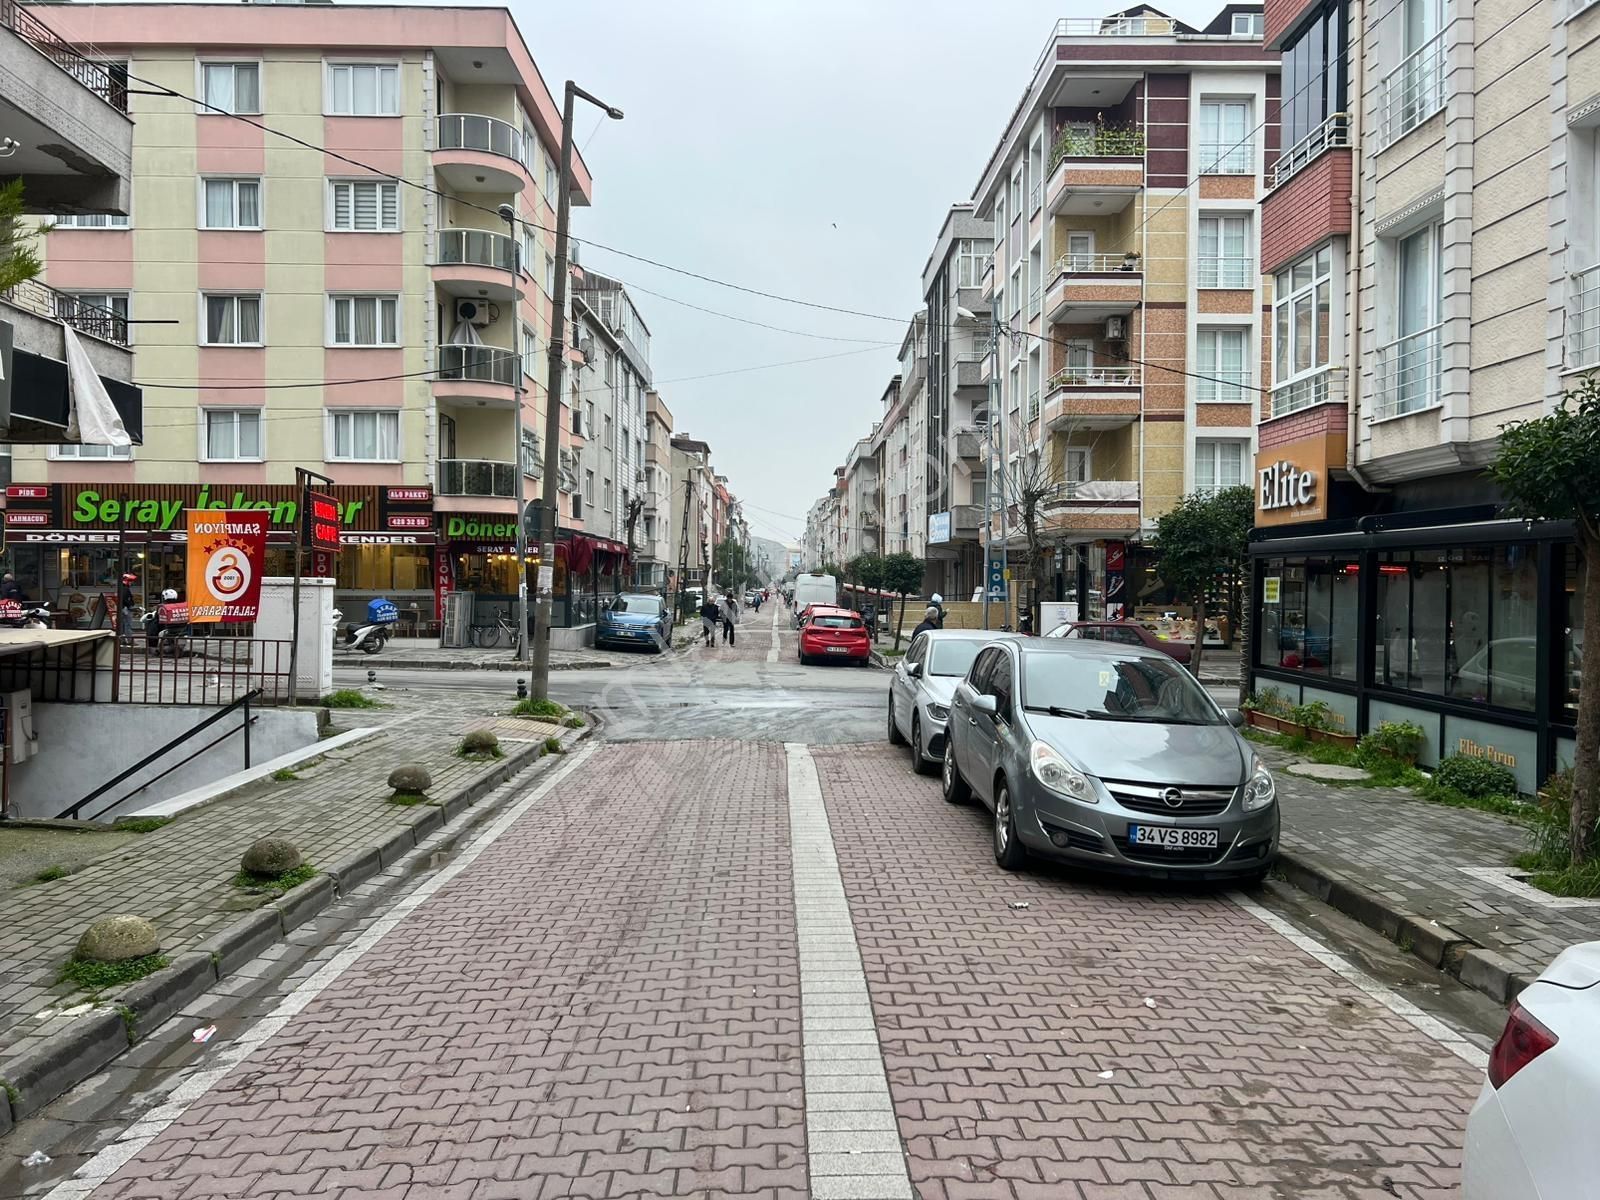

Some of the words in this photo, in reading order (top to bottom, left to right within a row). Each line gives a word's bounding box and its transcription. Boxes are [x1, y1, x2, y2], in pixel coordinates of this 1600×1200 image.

[1258, 461, 1316, 510] Elite
[73, 491, 183, 530] Seray
[197, 484, 362, 524] İknr
[26, 532, 120, 542] DÖNER
[339, 535, 417, 543] KENDER
[477, 545, 504, 553] SERAY
[1459, 738, 1484, 758] Elite
[1137, 828, 1155, 842] 34
[1158, 829, 1179, 844] VS
[1181, 831, 1217, 846] 8982
